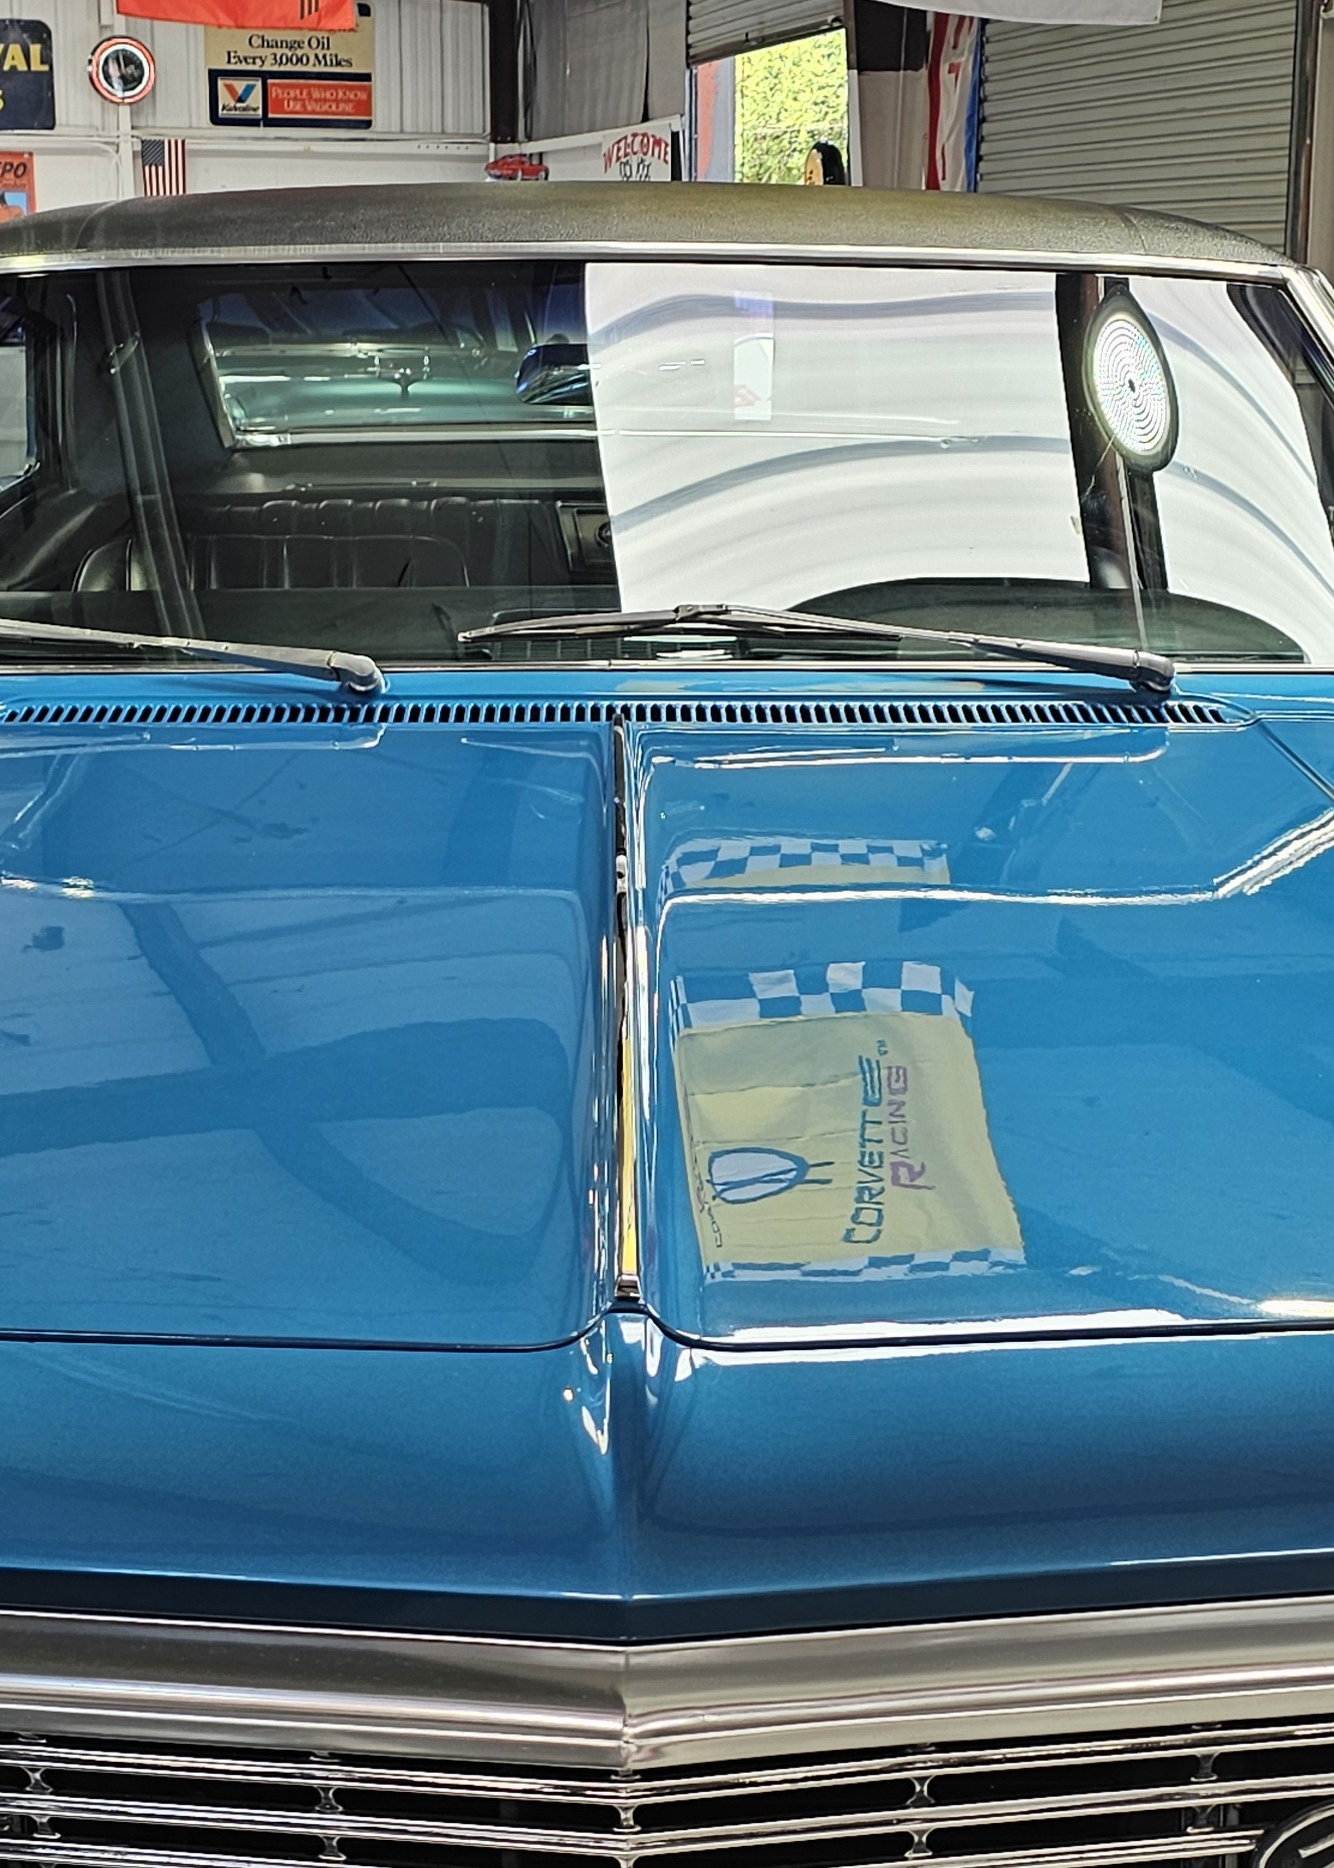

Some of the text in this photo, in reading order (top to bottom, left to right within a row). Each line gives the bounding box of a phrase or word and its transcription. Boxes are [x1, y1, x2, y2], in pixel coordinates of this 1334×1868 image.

[248, 33, 331, 52] Change Oil
[226, 50, 353, 68] Every 3,000 Miles
[271, 86, 367, 101] PEOPLE WHO KNOW
[221, 102, 260, 113] Valvoline
[284, 98, 304, 112] USE
[603, 131, 669, 174] WELCOME
[887, 1065, 935, 1190] RACING
[841, 1054, 885, 1244] CORVETTE
